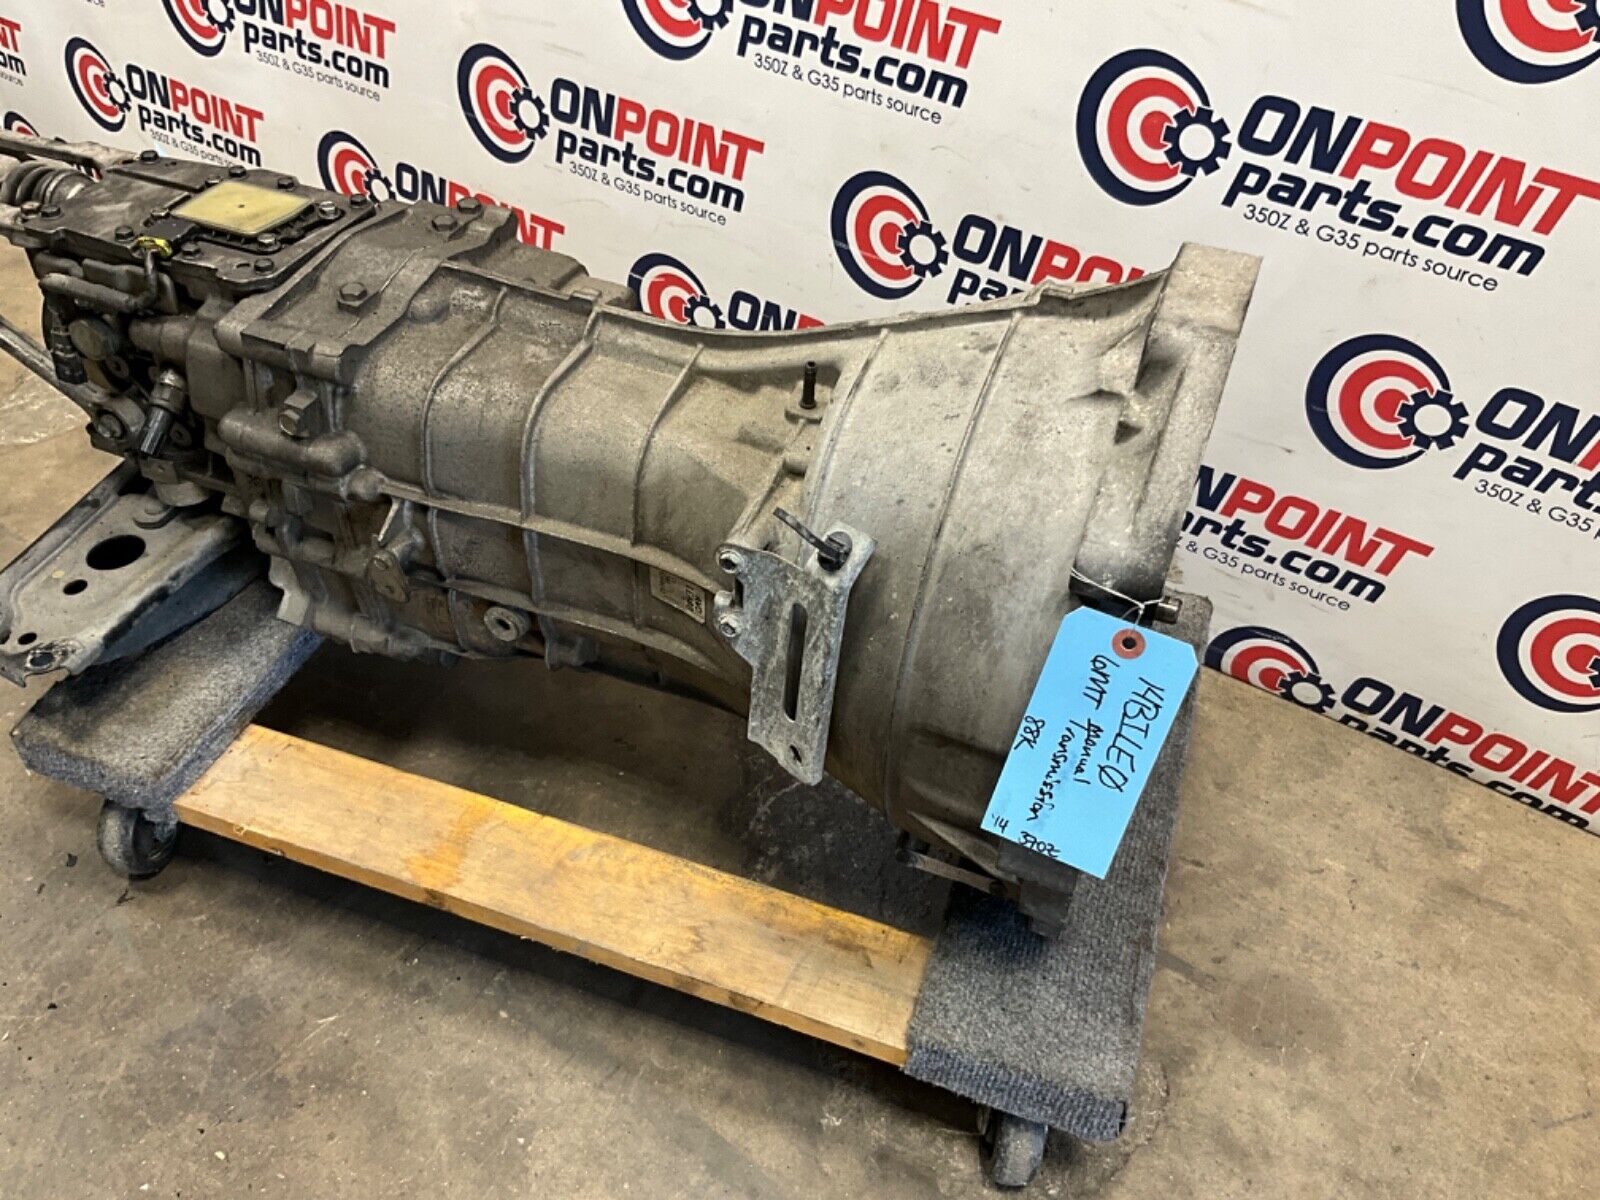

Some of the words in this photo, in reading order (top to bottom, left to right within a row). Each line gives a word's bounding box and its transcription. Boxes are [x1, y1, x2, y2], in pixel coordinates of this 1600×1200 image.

[243, 21, 389, 88] parts.com
[282, 58, 291, 71] &
[292, 61, 315, 79] G35
[316, 71, 344, 89] parts
[345, 81, 380, 102] source
[737, 15, 968, 108] parts.com
[754, 53, 788, 77] 350Z
[792, 65, 803, 82] &
[807, 69, 840, 92] G35
[843, 82, 883, 106] parts
[886, 97, 942, 125] source
[126, 64, 264, 143] ONPOINT
[138, 104, 262, 167] parts.com
[550, 77, 765, 181] ONPOINT
[556, 129, 745, 212] parts.com
[569, 161, 598, 182] 350Z
[601, 172, 611, 188] &
[614, 178, 641, 196] G35
[644, 189, 678, 209] parts
[680, 201, 727, 226] source
[1237, 95, 1600, 236] ONPOINT
[1221, 161, 1546, 276] parts.com
[1243, 204, 1292, 230] 350Z
[1295, 218, 1310, 237] &
[1316, 224, 1362, 250] G35
[1363, 241, 1419, 268] parts
[1422, 257, 1498, 292] source
[1194, 465, 1435, 577] NPOINT
[1475, 479, 1525, 507] 350Z
[1526, 498, 1542, 514] &
[1548, 506, 1595, 532] G35
[1181, 511, 1386, 603] rts.com
[1185, 540, 1198, 555] &
[1203, 547, 1240, 568] G35
[1241, 563, 1286, 588] parts
[1288, 582, 1350, 611] source
